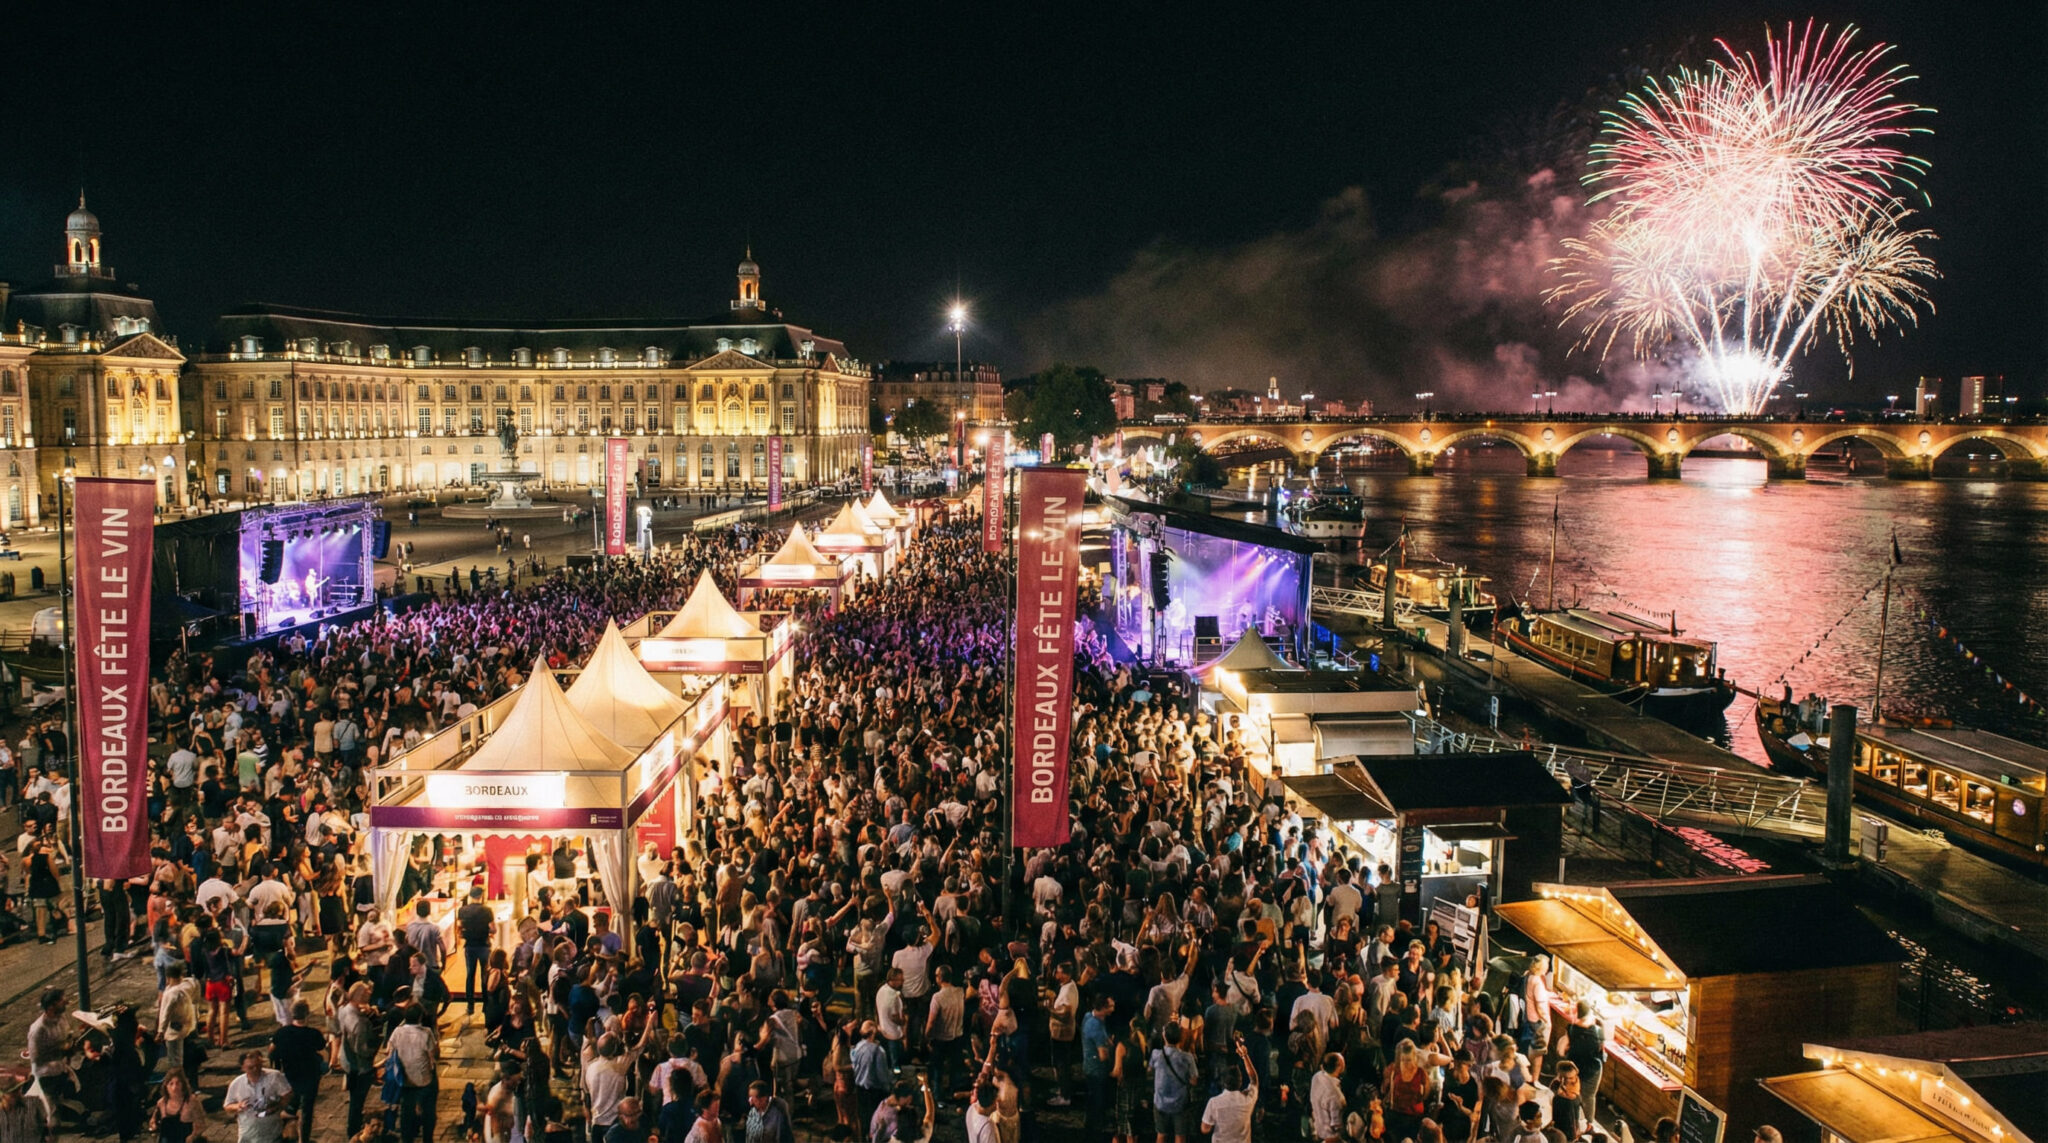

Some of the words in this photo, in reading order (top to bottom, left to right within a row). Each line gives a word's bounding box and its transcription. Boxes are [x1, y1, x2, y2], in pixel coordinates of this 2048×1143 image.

[101, 508, 129, 557] VIN
[1042, 497, 1067, 544] VIN
[101, 566, 128, 598] LE
[1041, 551, 1063, 581] LE
[93, 609, 128, 675] FÊTE
[1032, 591, 1062, 653] FÊTE
[1031, 663, 1058, 803] BORDEAUX
[102, 684, 128, 832] BORDEAUX
[465, 785, 528, 796] BORDEAUX
